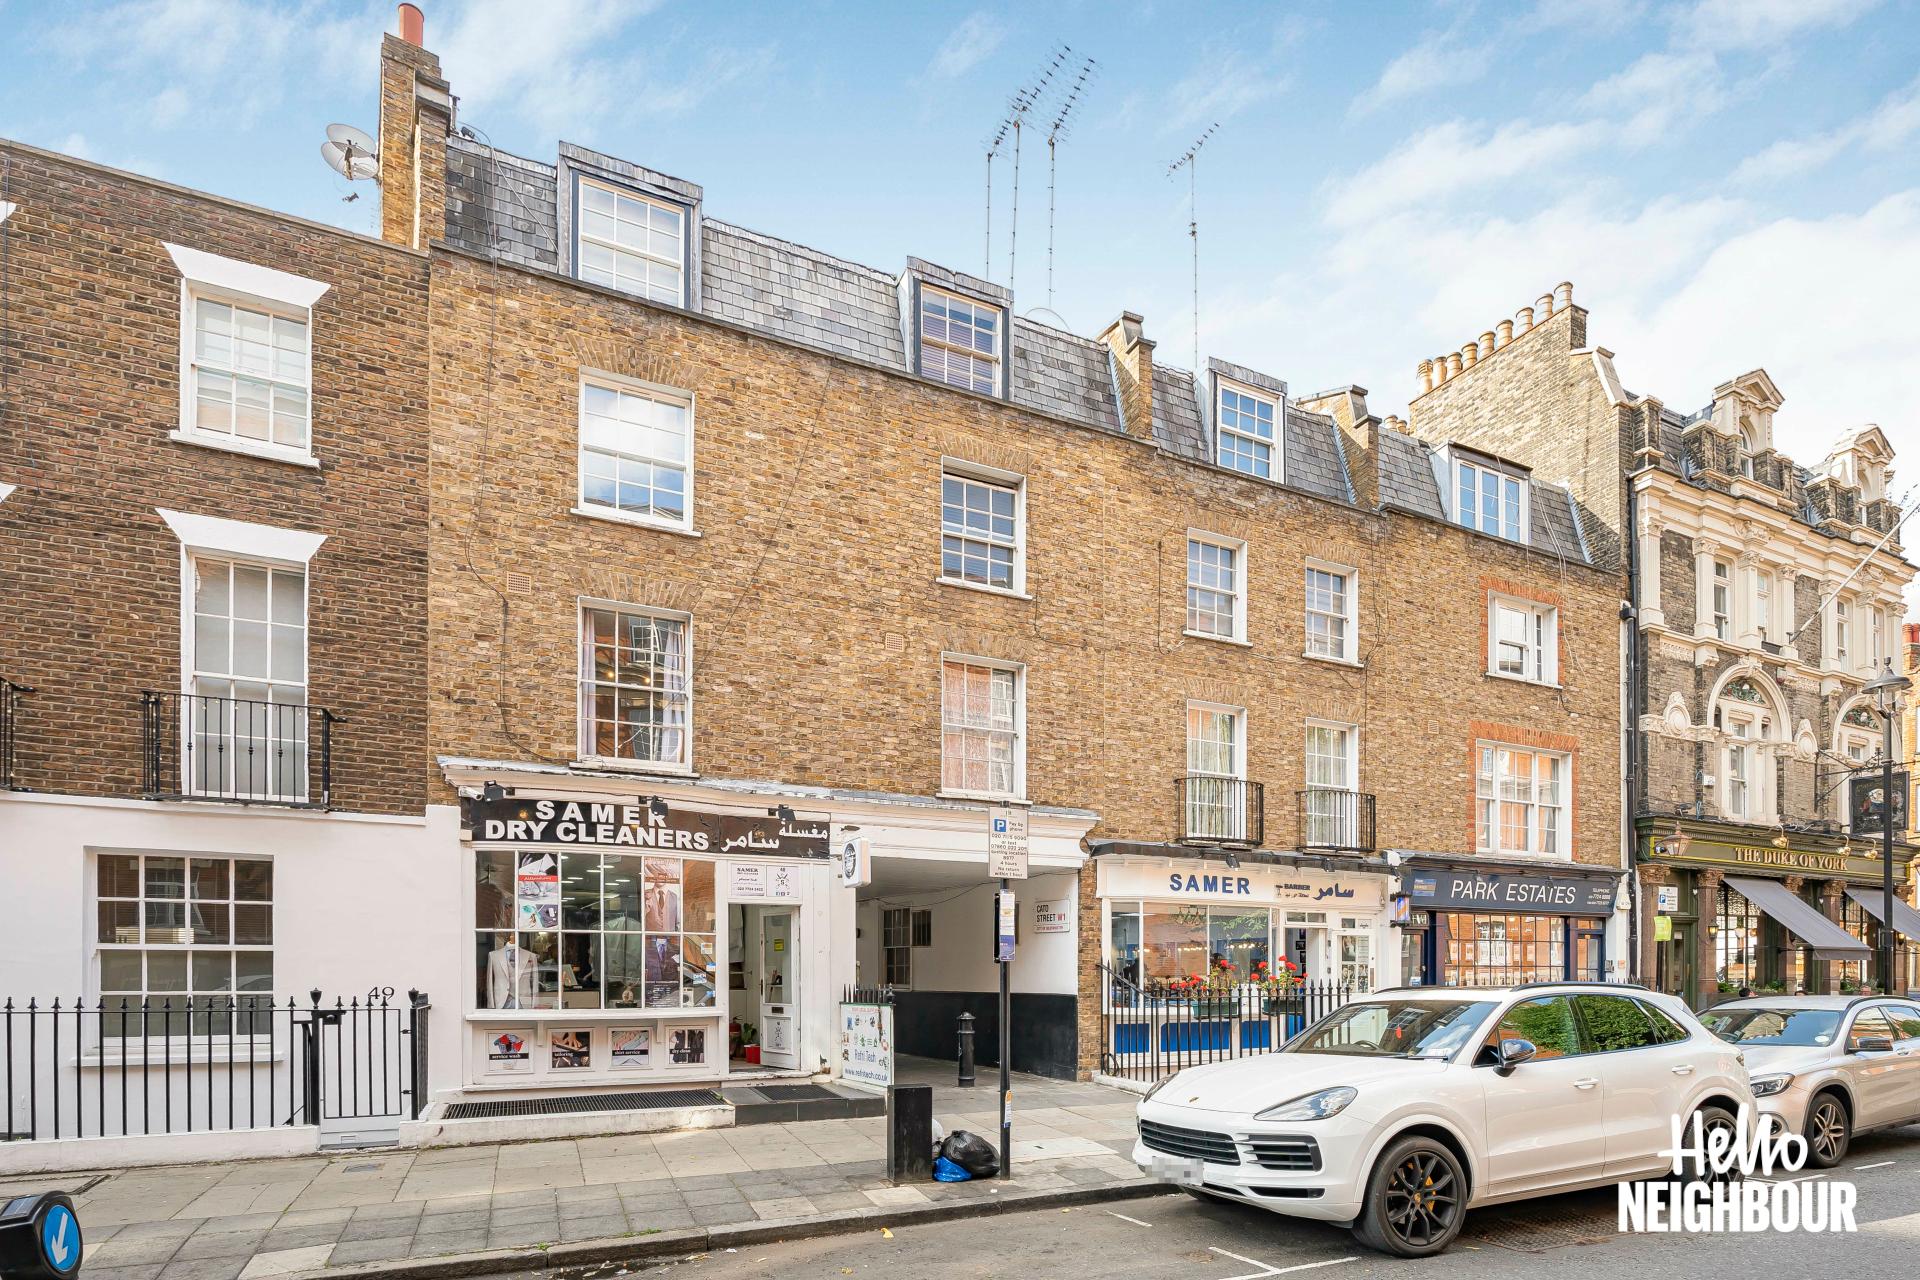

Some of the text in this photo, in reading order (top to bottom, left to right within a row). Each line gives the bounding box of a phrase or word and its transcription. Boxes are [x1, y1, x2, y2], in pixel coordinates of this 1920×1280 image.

[535, 800, 667, 828] SAMER
[485, 820, 710, 851] DRY CLEANERS
[720, 830, 780, 852] سامر
[1735, 847, 1849, 871] THE DUKE OF YORK
[1169, 873, 1250, 895] SAMER
[1311, 882, 1355, 901] سامر
[1451, 880, 1500, 900] PARK
[1505, 883, 1577, 904] ESTATES
[1036, 904, 1049, 913] CATO
[1036, 913, 1066, 922] STREET W1
[368, 986, 395, 1001] 49
